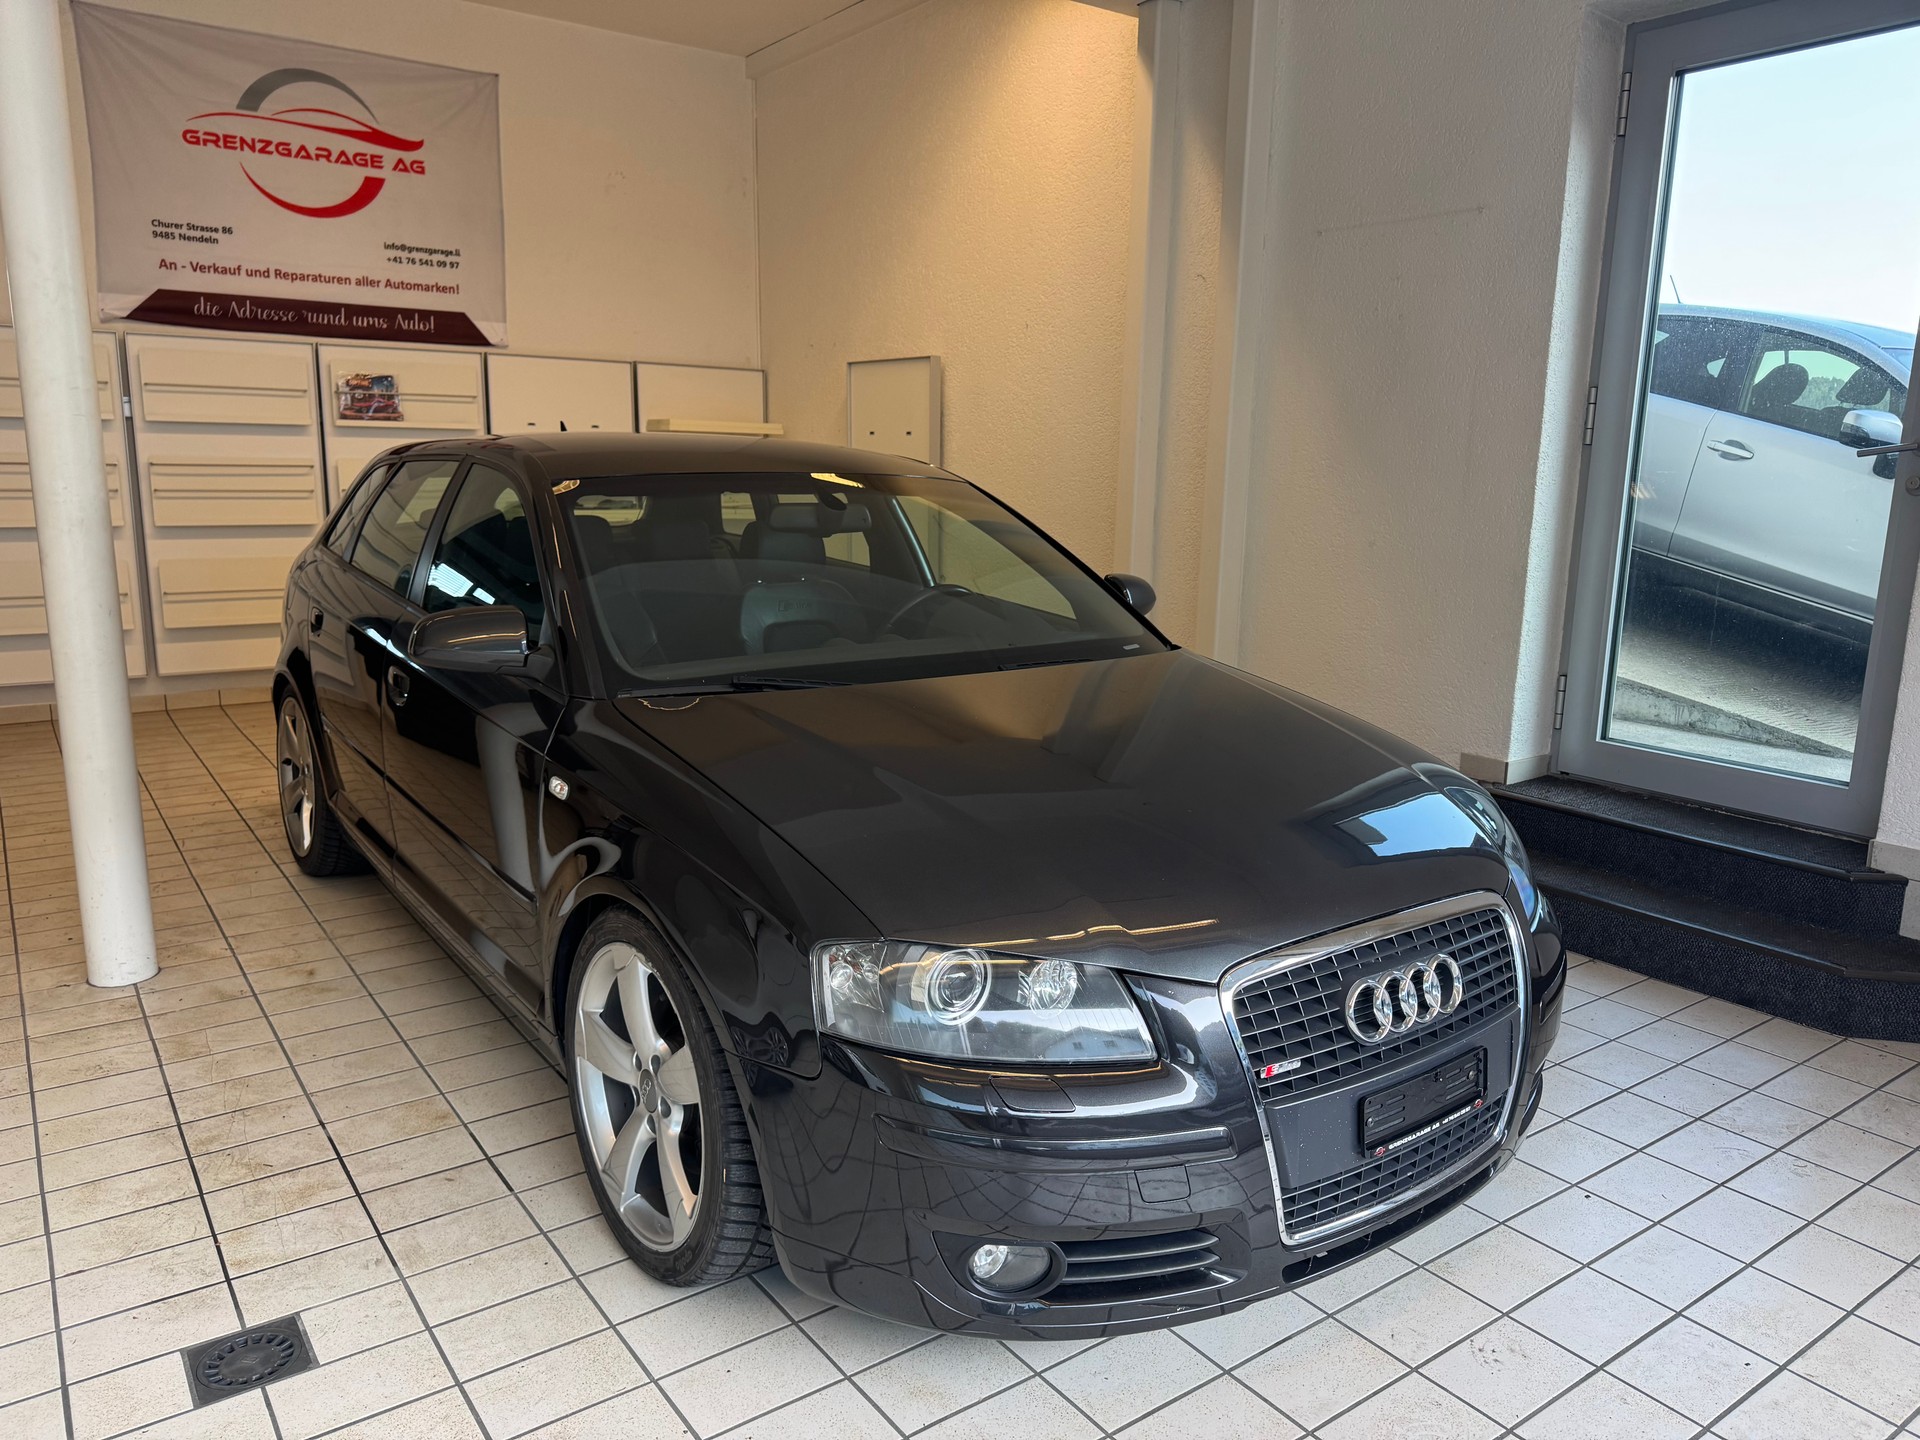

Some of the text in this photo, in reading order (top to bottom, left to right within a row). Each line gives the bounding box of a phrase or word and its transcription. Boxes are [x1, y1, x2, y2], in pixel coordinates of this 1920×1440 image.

[182, 128, 426, 175] GRENZGARAGE AG
[151, 219, 234, 235] Churer Strasse 86
[152, 230, 219, 245] 9485 Nendeln
[383, 241, 461, 258] info@grenzgarage.li
[386, 256, 460, 270] +41 76 541 09 97
[159, 258, 177, 271] An
[190, 261, 242, 277] Verkauf
[245, 267, 271, 279] und
[274, 268, 352, 286] Reparaturen
[355, 276, 381, 288] aller
[384, 278, 460, 295] Automarken!
[194, 296, 436, 333] die Adresse rund ums Auto!
